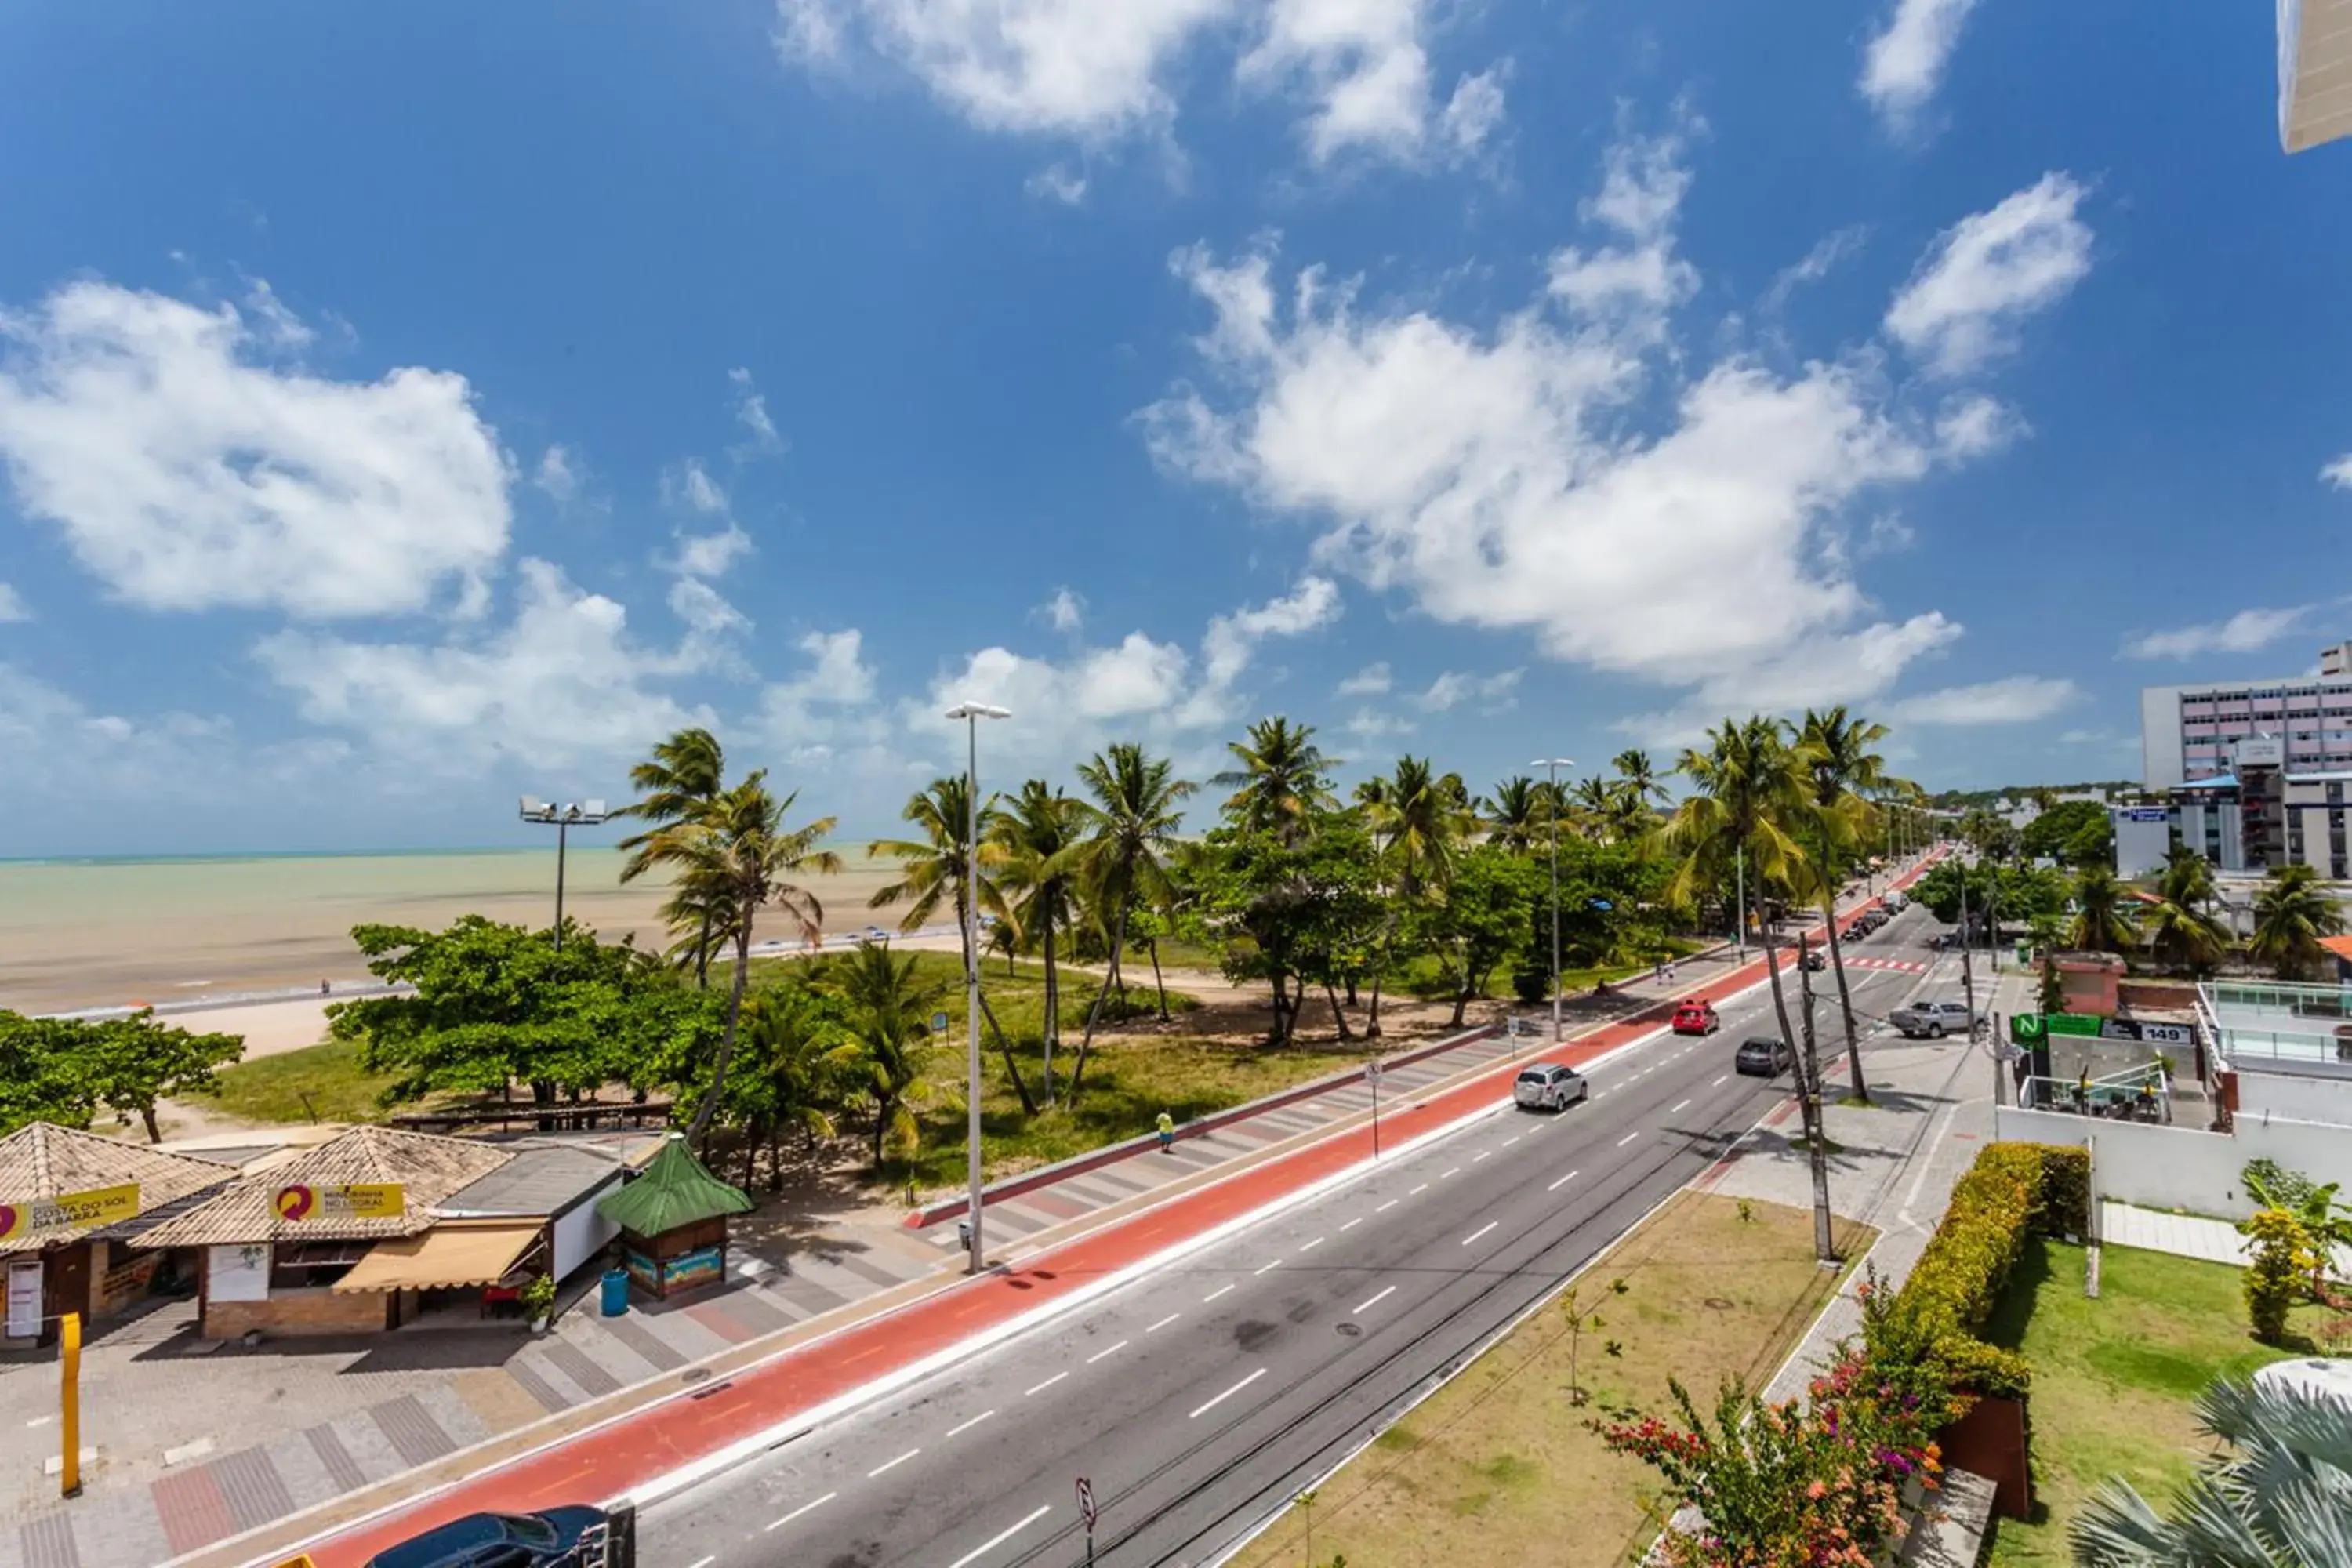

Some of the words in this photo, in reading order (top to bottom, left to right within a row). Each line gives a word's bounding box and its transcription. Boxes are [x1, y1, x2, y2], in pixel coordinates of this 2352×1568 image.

[2147, 1028, 2180, 1040] 149
[33, 1205, 77, 1219] COSTA
[81, 1201, 101, 1211] DO
[104, 1196, 126, 1207] SOL
